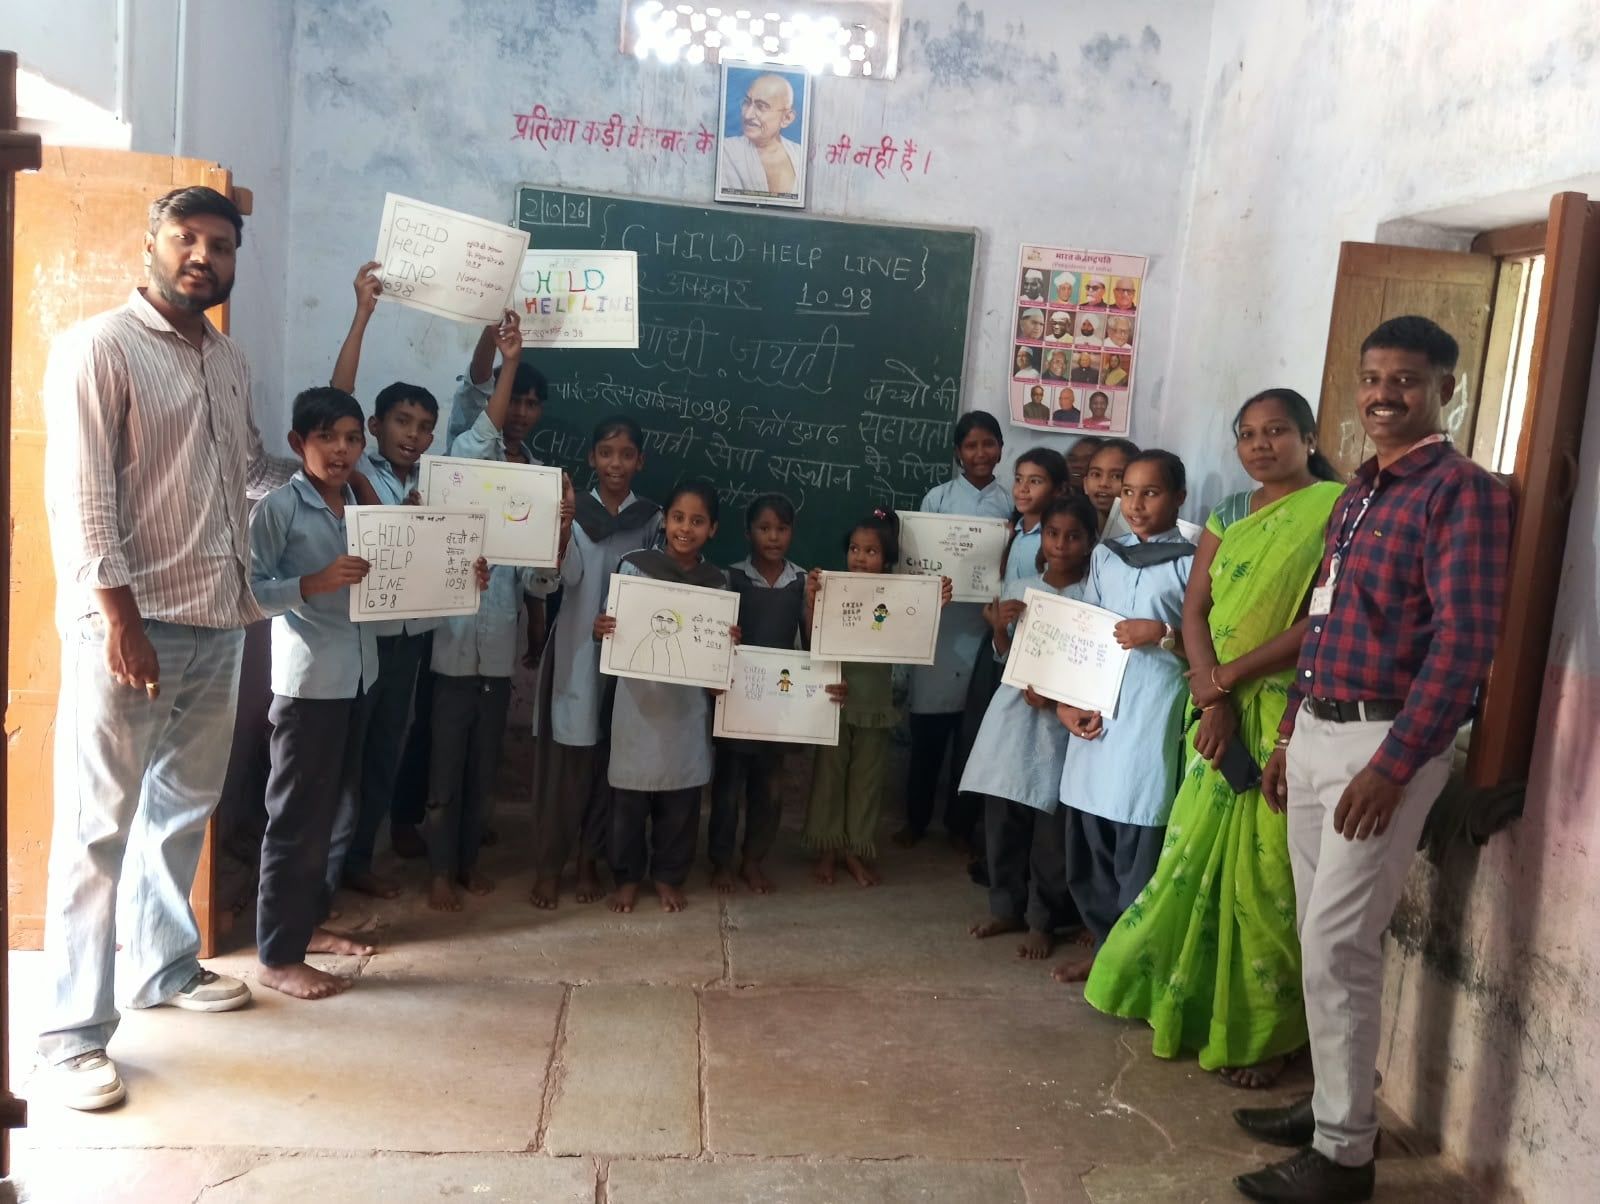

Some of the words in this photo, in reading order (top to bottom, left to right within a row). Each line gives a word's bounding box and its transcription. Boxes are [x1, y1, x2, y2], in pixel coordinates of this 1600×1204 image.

[525, 198, 538, 216] 2
[395, 217, 449, 243] CHILD
[520, 268, 605, 294] CHILD
[796, 282, 872, 310] 1098
[362, 523, 416, 547] CHILD
[368, 548, 413, 571] HELP
[368, 575, 406, 591] LINE
[365, 593, 397, 609] 1098
